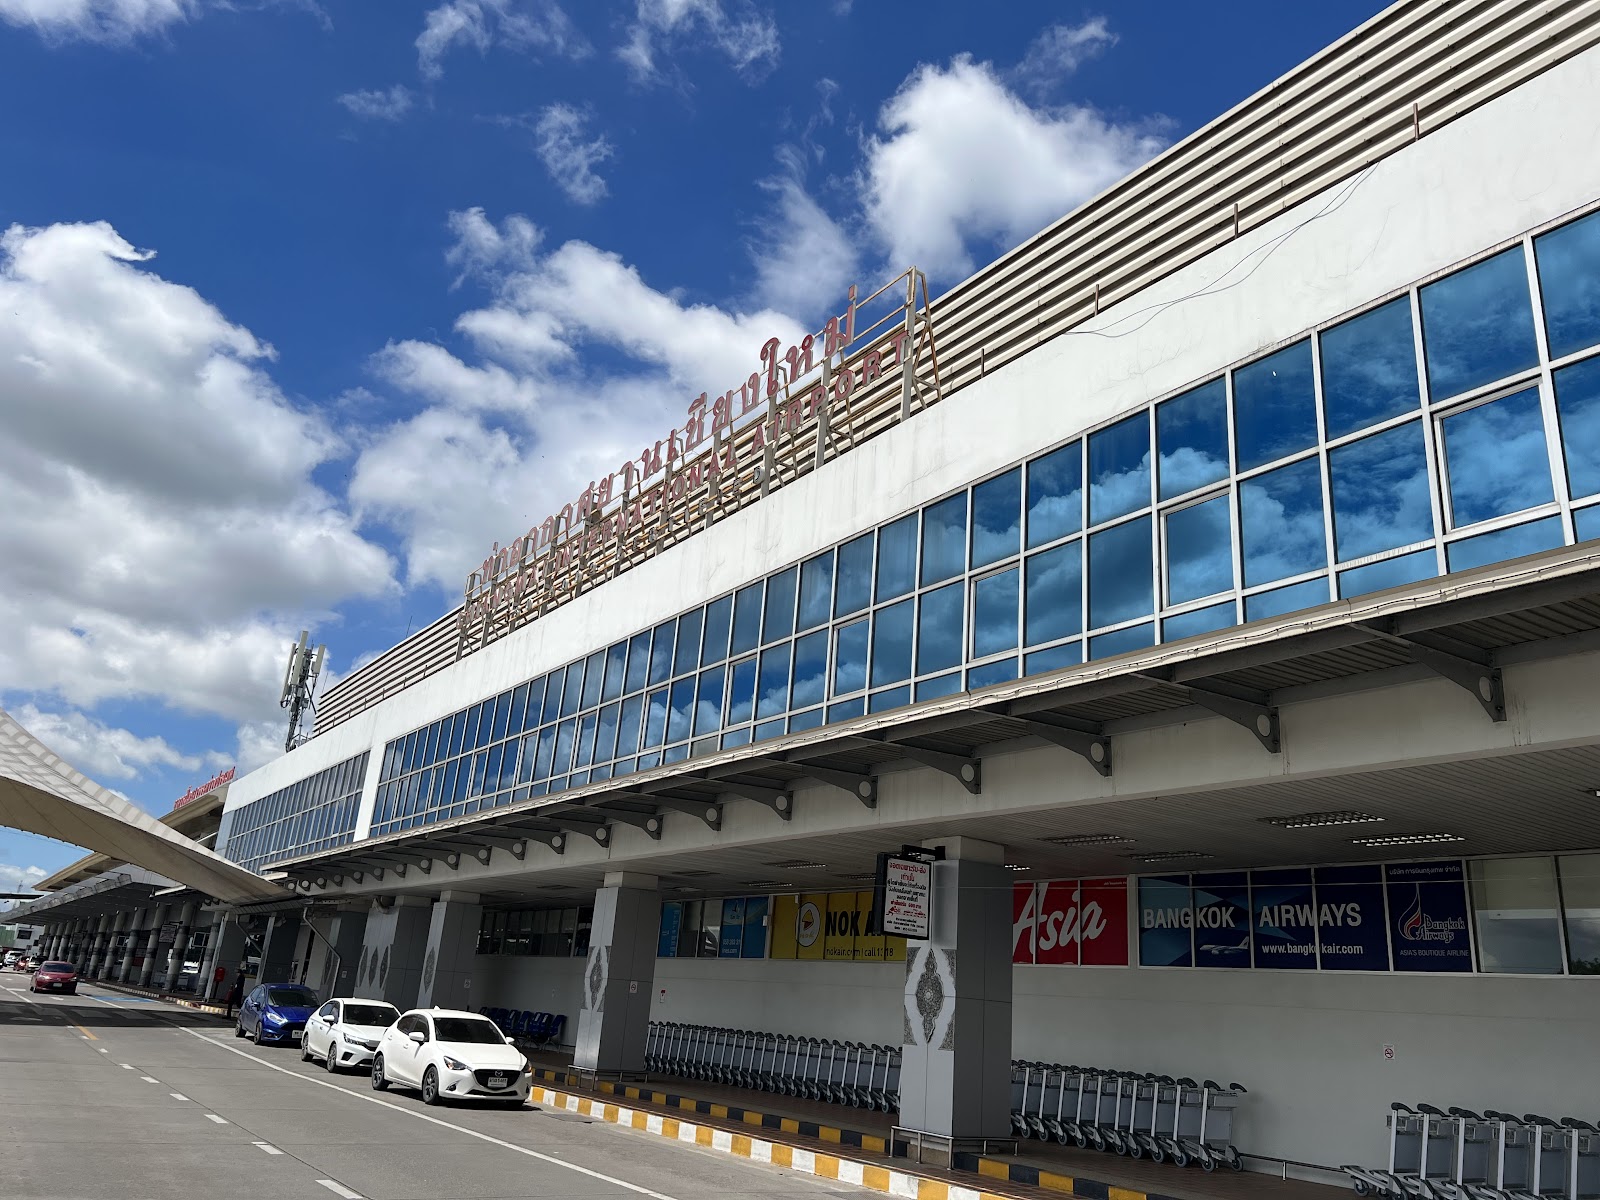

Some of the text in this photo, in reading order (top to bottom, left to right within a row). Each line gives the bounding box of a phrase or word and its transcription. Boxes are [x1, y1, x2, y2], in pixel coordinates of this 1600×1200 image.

[482, 284, 857, 583] ท่าอากาศยานเชียงใหม่
[555, 442, 738, 571] INTERNATIONAL
[751, 330, 911, 455] AIRPORT
[825, 911, 861, 936] NOK
[1143, 903, 1362, 928] BANGKOK AIRWAYS
[1423, 913, 1465, 931] Bangkok
[1416, 924, 1454, 943] Airways
[864, 947, 876, 957] call
